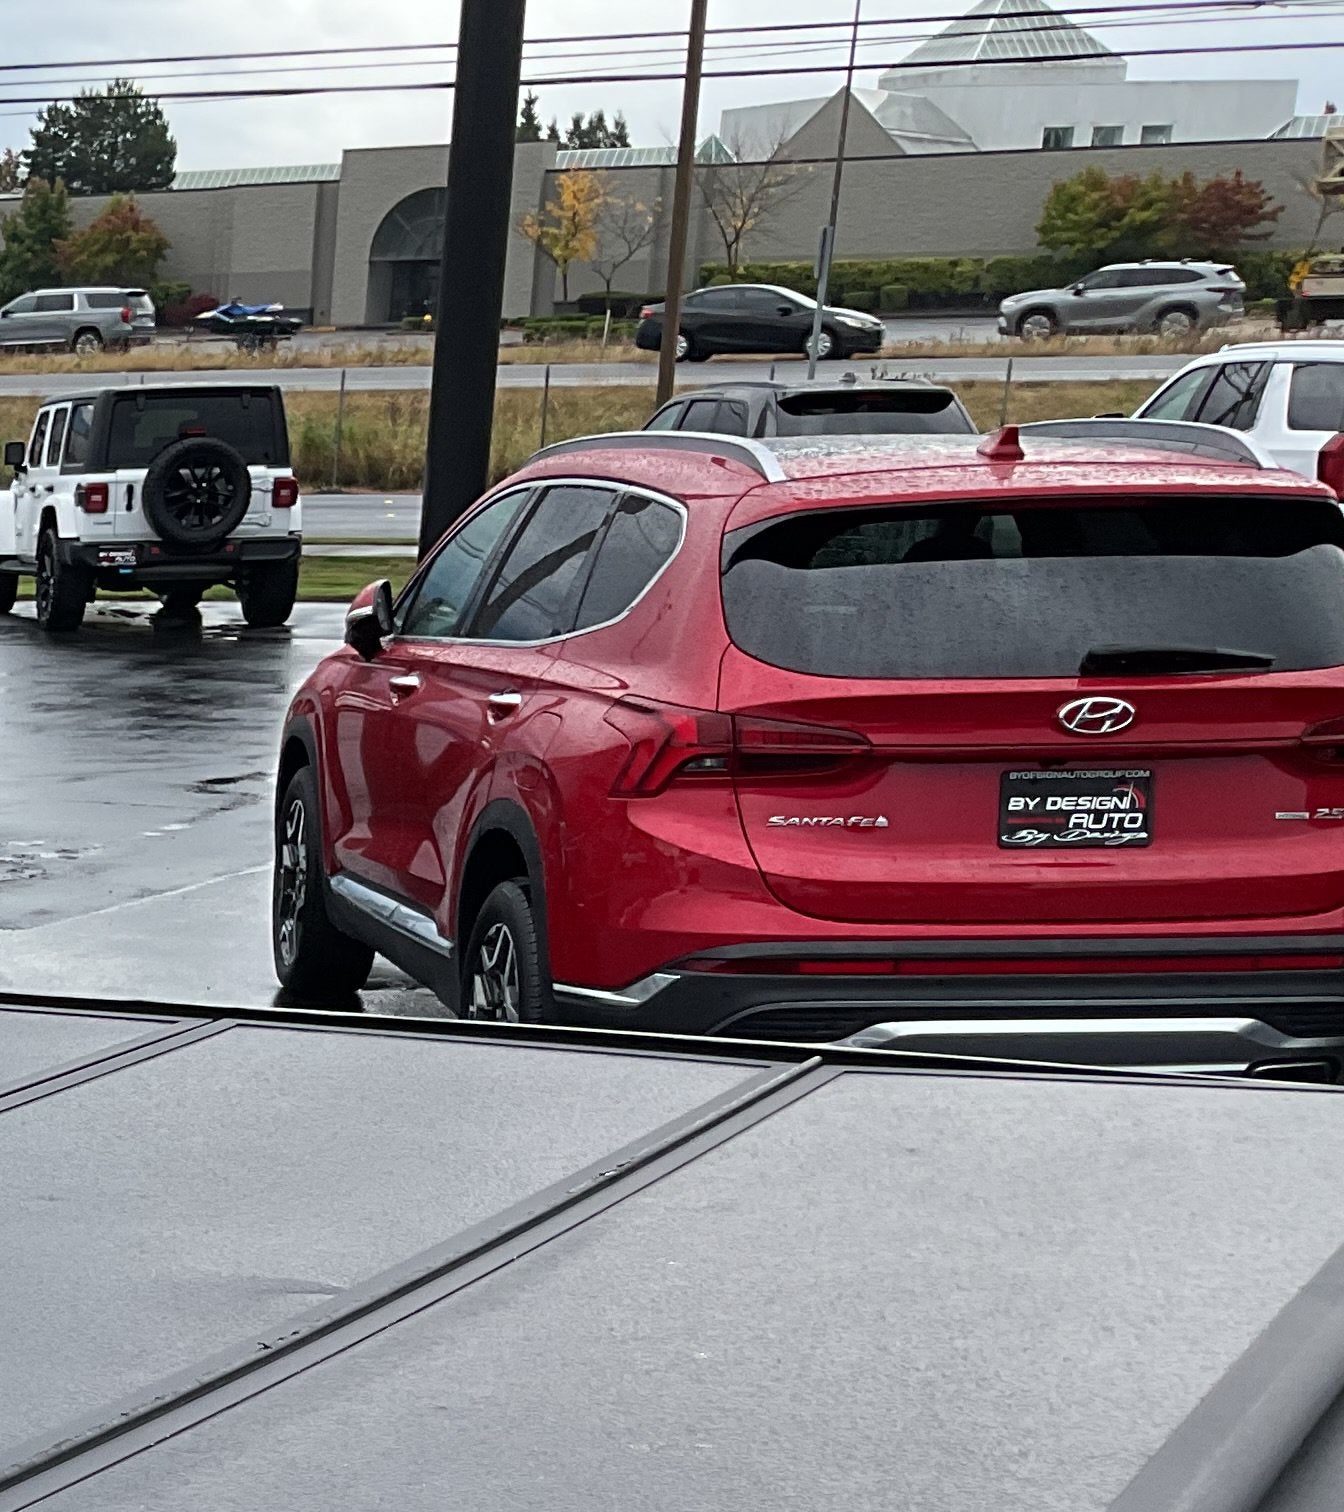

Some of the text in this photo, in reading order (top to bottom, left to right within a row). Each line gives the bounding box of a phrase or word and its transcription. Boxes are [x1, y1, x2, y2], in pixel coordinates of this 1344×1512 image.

[1007, 796, 1130, 811] BY DESIGN
[1068, 812, 1144, 829] AUTO
